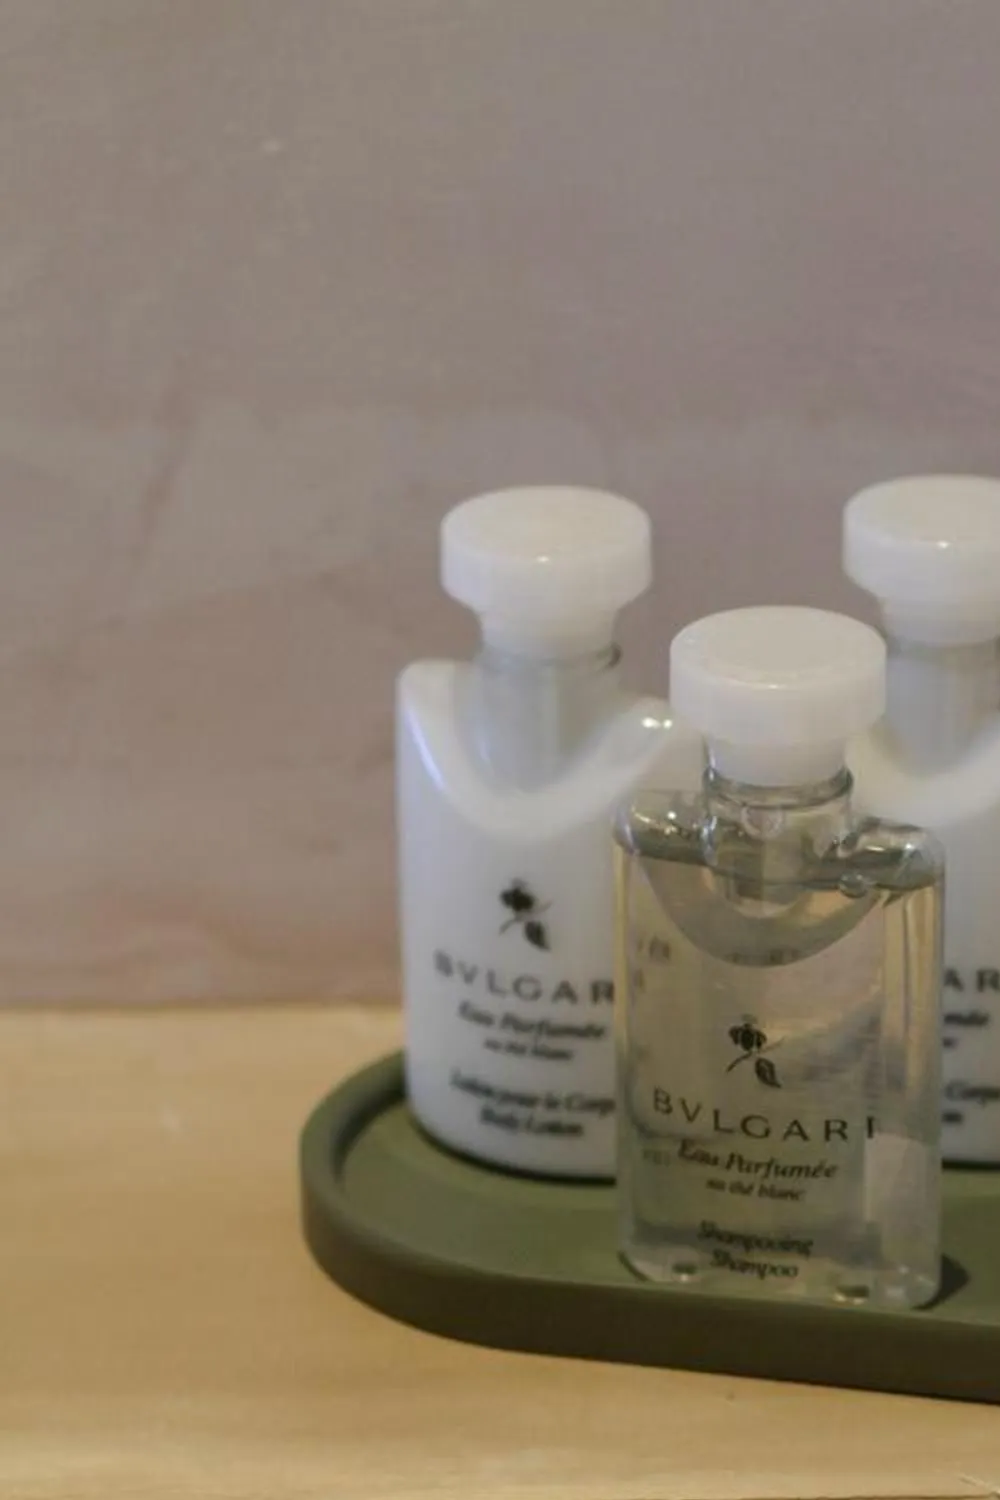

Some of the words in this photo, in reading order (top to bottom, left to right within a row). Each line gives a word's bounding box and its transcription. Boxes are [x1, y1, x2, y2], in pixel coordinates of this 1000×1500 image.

[432, 949, 616, 1005] BVLGAR
[653, 1086, 876, 1142] BVLGARI
[678, 1139, 720, 1167] Eau
[725, 1152, 839, 1181] Parfumée
